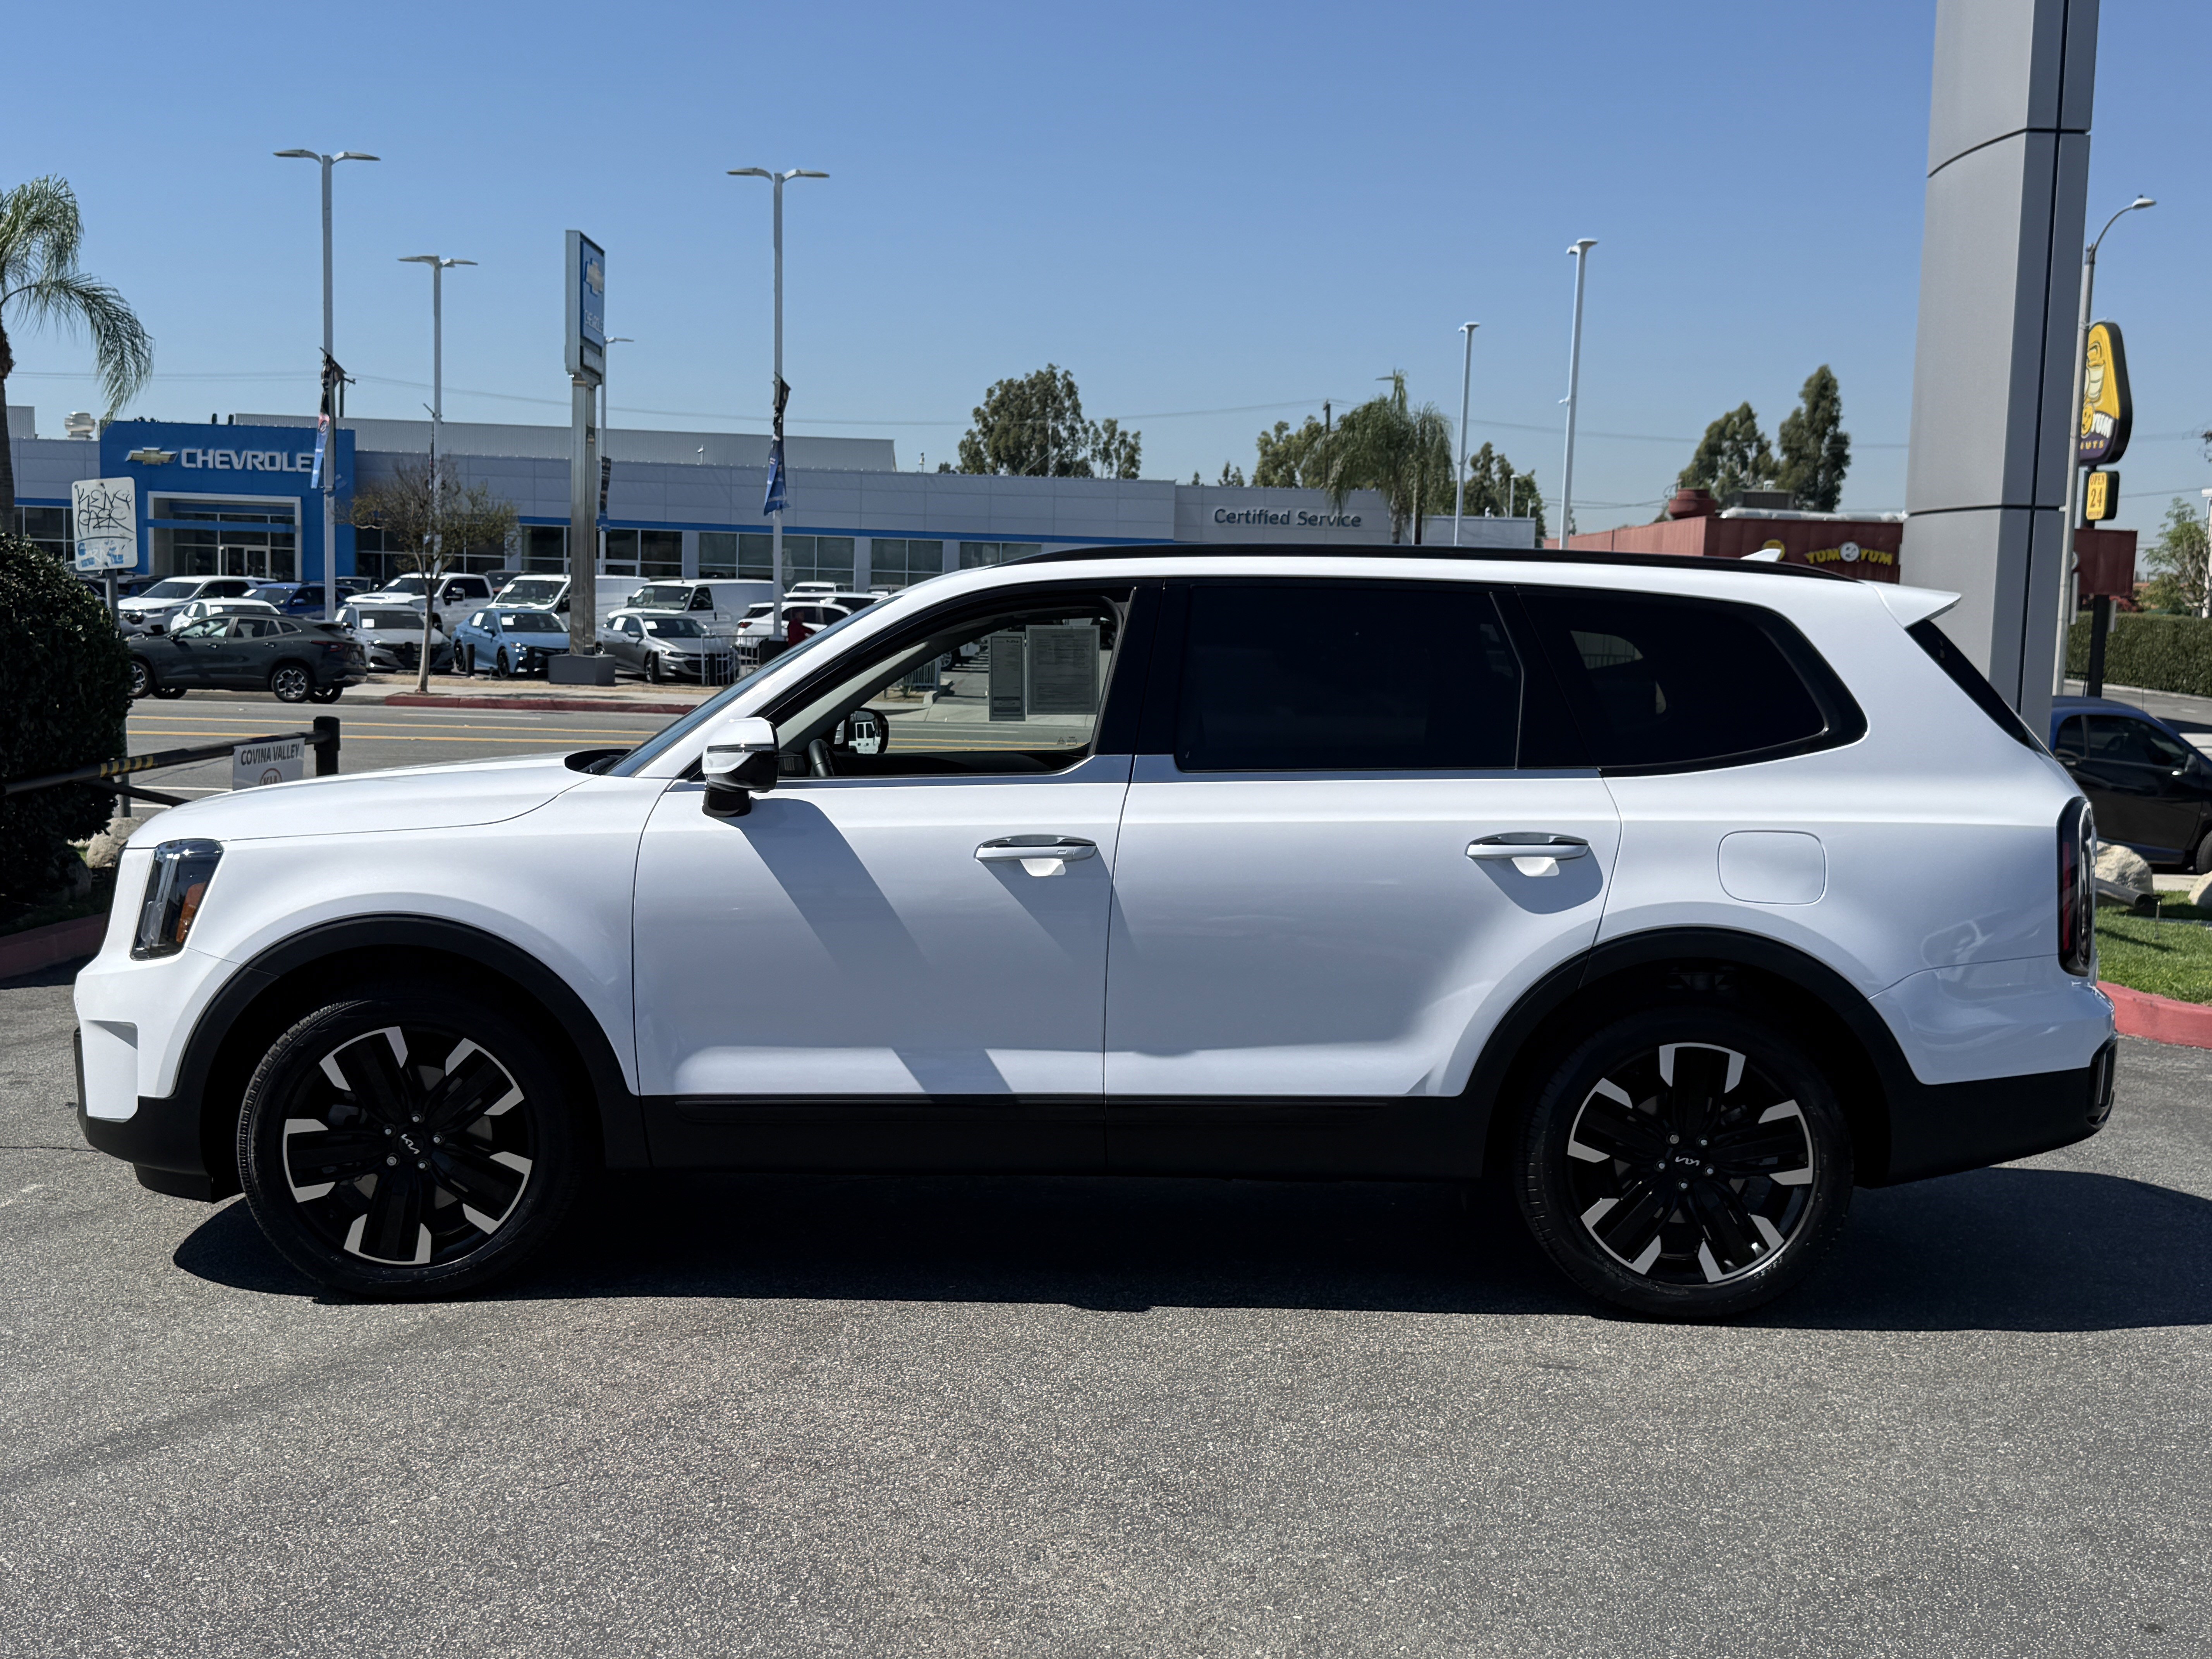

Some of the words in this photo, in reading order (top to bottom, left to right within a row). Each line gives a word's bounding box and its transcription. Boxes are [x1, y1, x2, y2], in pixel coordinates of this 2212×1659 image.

[2091, 412, 2113, 438] YUM
[2080, 440, 2104, 450] UTS
[181, 448, 315, 472] CHEVROLE
[2090, 487, 2103, 508] 24
[1214, 508, 1290, 525] Certified
[1297, 511, 1362, 527] Service
[1804, 548, 1840, 564] YUM
[1860, 548, 1893, 566] YUM
[241, 747, 271, 766] COVINA
[273, 744, 300, 761] VALLEY
